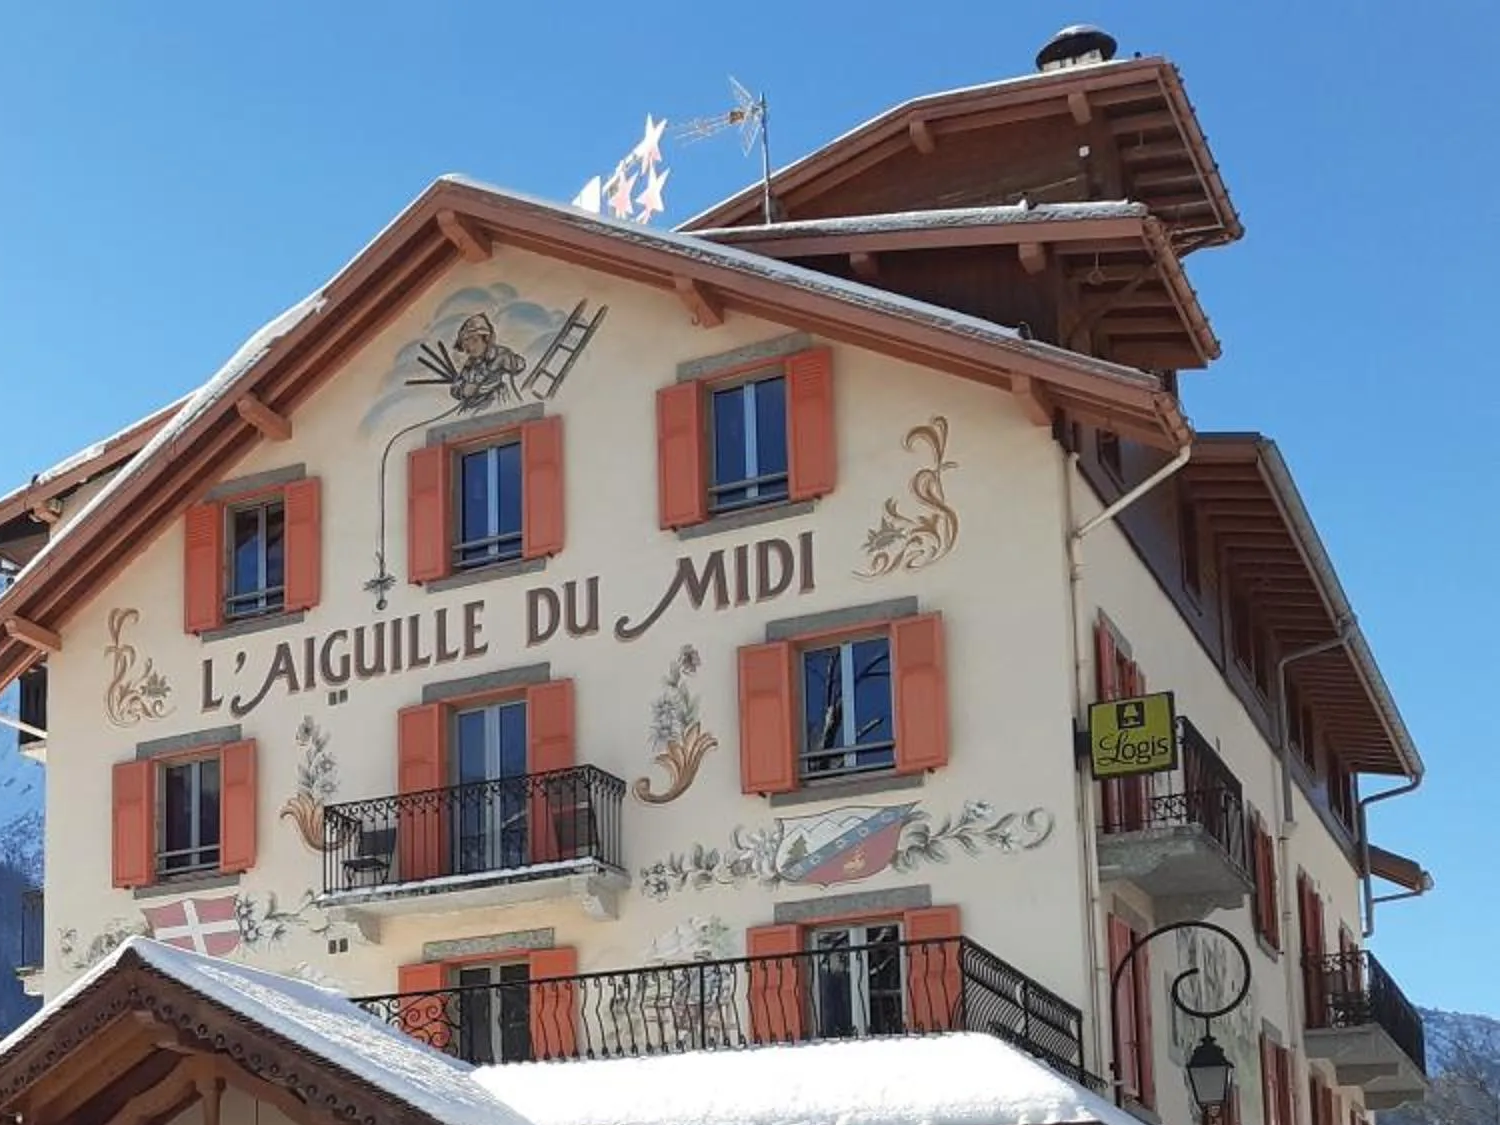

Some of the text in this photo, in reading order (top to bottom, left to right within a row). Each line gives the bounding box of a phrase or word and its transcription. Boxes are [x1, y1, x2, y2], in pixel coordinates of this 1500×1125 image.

[201, 530, 816, 718] L'AIGUILLE DU MIDI
[1096, 730, 1169, 765] Logis
